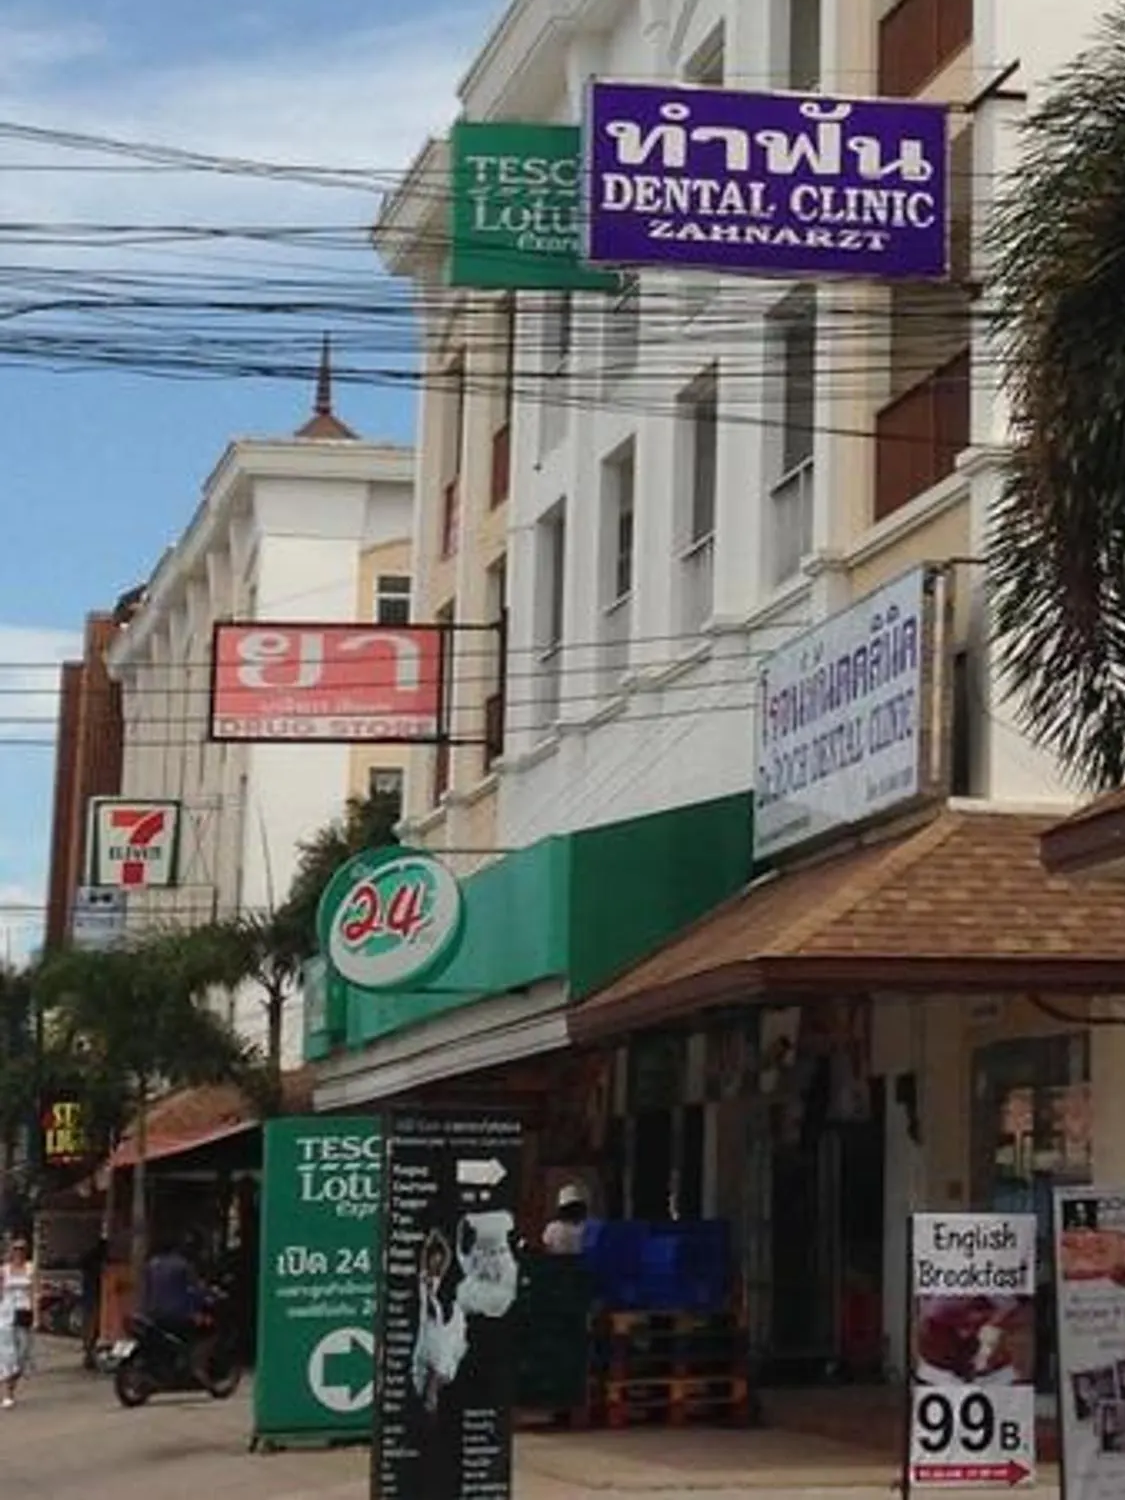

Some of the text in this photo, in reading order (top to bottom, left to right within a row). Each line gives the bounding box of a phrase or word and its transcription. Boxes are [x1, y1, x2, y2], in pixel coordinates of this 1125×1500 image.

[605, 101, 934, 182] ทำฟัน
[465, 155, 577, 187] TESC
[472, 195, 578, 234] Lotu
[601, 172, 936, 229] DENTAL CLINIC
[648, 218, 892, 251] ZAHNARZT
[296, 1135, 382, 1160] TESC
[301, 1171, 380, 1201] Lotu
[933, 1221, 1018, 1259] English
[335, 1247, 371, 1275] 24
[918, 1259, 1028, 1288] Breakfast
[918, 1392, 995, 1452] 99
